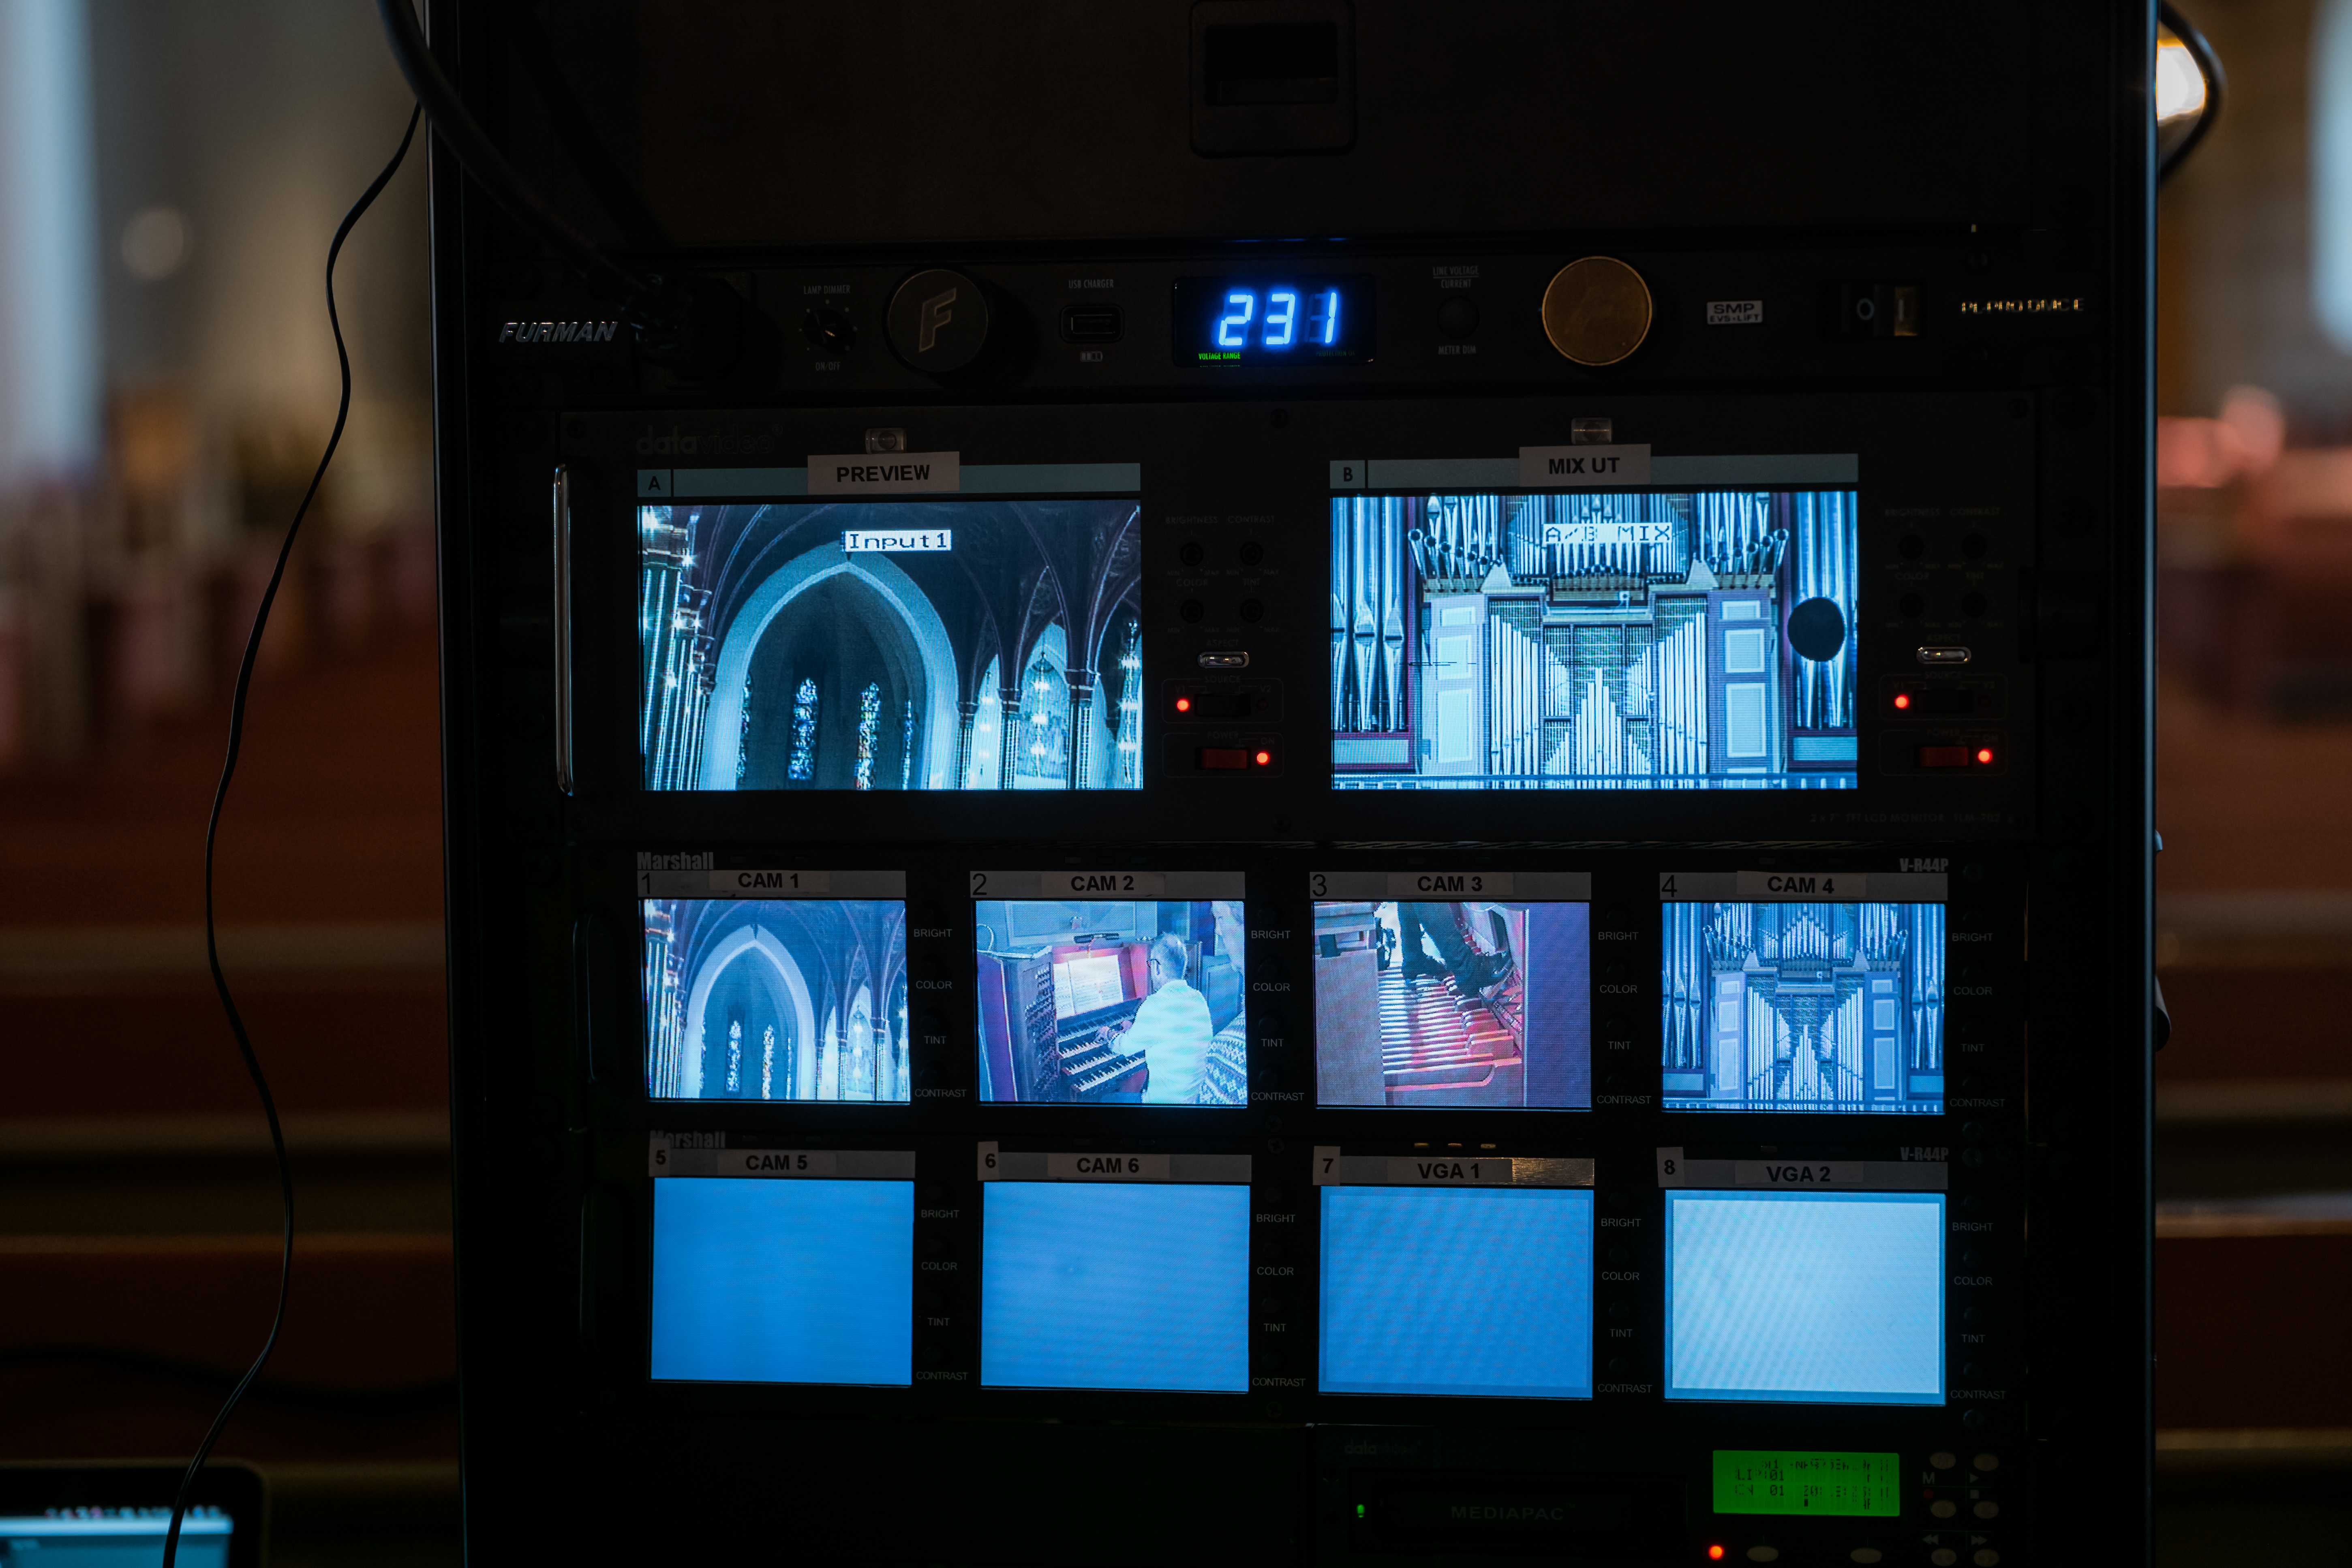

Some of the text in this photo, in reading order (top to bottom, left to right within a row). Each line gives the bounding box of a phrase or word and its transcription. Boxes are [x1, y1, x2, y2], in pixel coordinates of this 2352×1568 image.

[1433, 265, 1479, 276] LINE VOLTAGE
[1069, 279, 1114, 289] USB CHARGER
[1441, 279, 1472, 288] CURRENT
[804, 285, 850, 294] LAMP DIMMER
[1714, 303, 1754, 314] SMP
[1218, 292, 1337, 346] 231
[499, 321, 618, 343] FURMAN
[1438, 345, 1476, 355] METER DIM
[815, 362, 841, 371] ON/OFF
[1549, 457, 1620, 474] MIX UT
[837, 464, 930, 483] PREVIEW
[1344, 467, 1353, 482] B
[648, 476, 661, 490] A
[1165, 515, 1275, 524] BRIGHTNESS CONTRAST
[1618, 526, 1670, 541] MIX
[850, 533, 946, 550] Input1
[1176, 578, 1261, 587] COLOR TINT
[1207, 732, 1239, 740] POWER
[637, 851, 714, 870] Marshall
[1899, 858, 1949, 872] V-R44P
[641, 873, 651, 894] 1
[738, 873, 798, 888] CAM 1
[972, 874, 987, 895] 2
[1070, 875, 1134, 891] CAM 2
[1312, 874, 1327, 896] 3
[1418, 876, 1483, 892] CAM 3
[1767, 876, 1834, 894] CAM 4
[1661, 875, 1677, 897] 4
[914, 929, 952, 937] BRIGHT
[1251, 930, 1290, 939] BRIGHT
[1598, 931, 1639, 940] BRIGHT
[1952, 933, 1993, 942] BRIGHT
[916, 980, 952, 989] COLOR
[1253, 982, 1290, 991] COLOR
[1599, 984, 1637, 994] COLOR
[1953, 986, 1992, 996] COLOR
[924, 1035, 947, 1044] TINT
[1261, 1038, 1284, 1047] TINT
[1607, 1041, 1631, 1050] TINT
[1960, 1043, 1986, 1052] TINT
[915, 1089, 967, 1097] CONTRAST
[1251, 1092, 1305, 1101] CONTRAST
[1597, 1095, 1652, 1104] CONTRAST
[1950, 1098, 2007, 1108] CONTRAST
[656, 1150, 666, 1165] 5
[1900, 1146, 1949, 1162] V-R44P
[746, 1155, 807, 1171] CAM 5
[985, 1153, 995, 1168] 6
[1077, 1157, 1139, 1174] CAM 6
[1322, 1158, 1334, 1173] 7
[1417, 1163, 1480, 1179] VGA 1
[1664, 1159, 1676, 1175] 8
[1766, 1166, 1831, 1182] VGA 2
[920, 1209, 959, 1218] BRIGHT
[1256, 1214, 1296, 1223] BRIGHT
[1601, 1218, 1641, 1227] BRIGHT
[1952, 1222, 1994, 1232] BRIGHT
[921, 1262, 958, 1271] COLOR
[1257, 1266, 1294, 1275] COLOR
[1602, 1271, 1640, 1281] COLOR
[1954, 1276, 1993, 1286] COLOR
[927, 1318, 950, 1326] TINT
[1263, 1323, 1287, 1332] TINT
[1609, 1328, 1633, 1338] TINT
[1961, 1334, 1986, 1343] TINT
[916, 1371, 968, 1380] CONTRAST
[1252, 1378, 1306, 1387] CONTRAST
[1597, 1383, 1652, 1393] CONTRAST
[1950, 1390, 2006, 1399] CONTRAST
[1922, 1472, 1935, 1484] M
